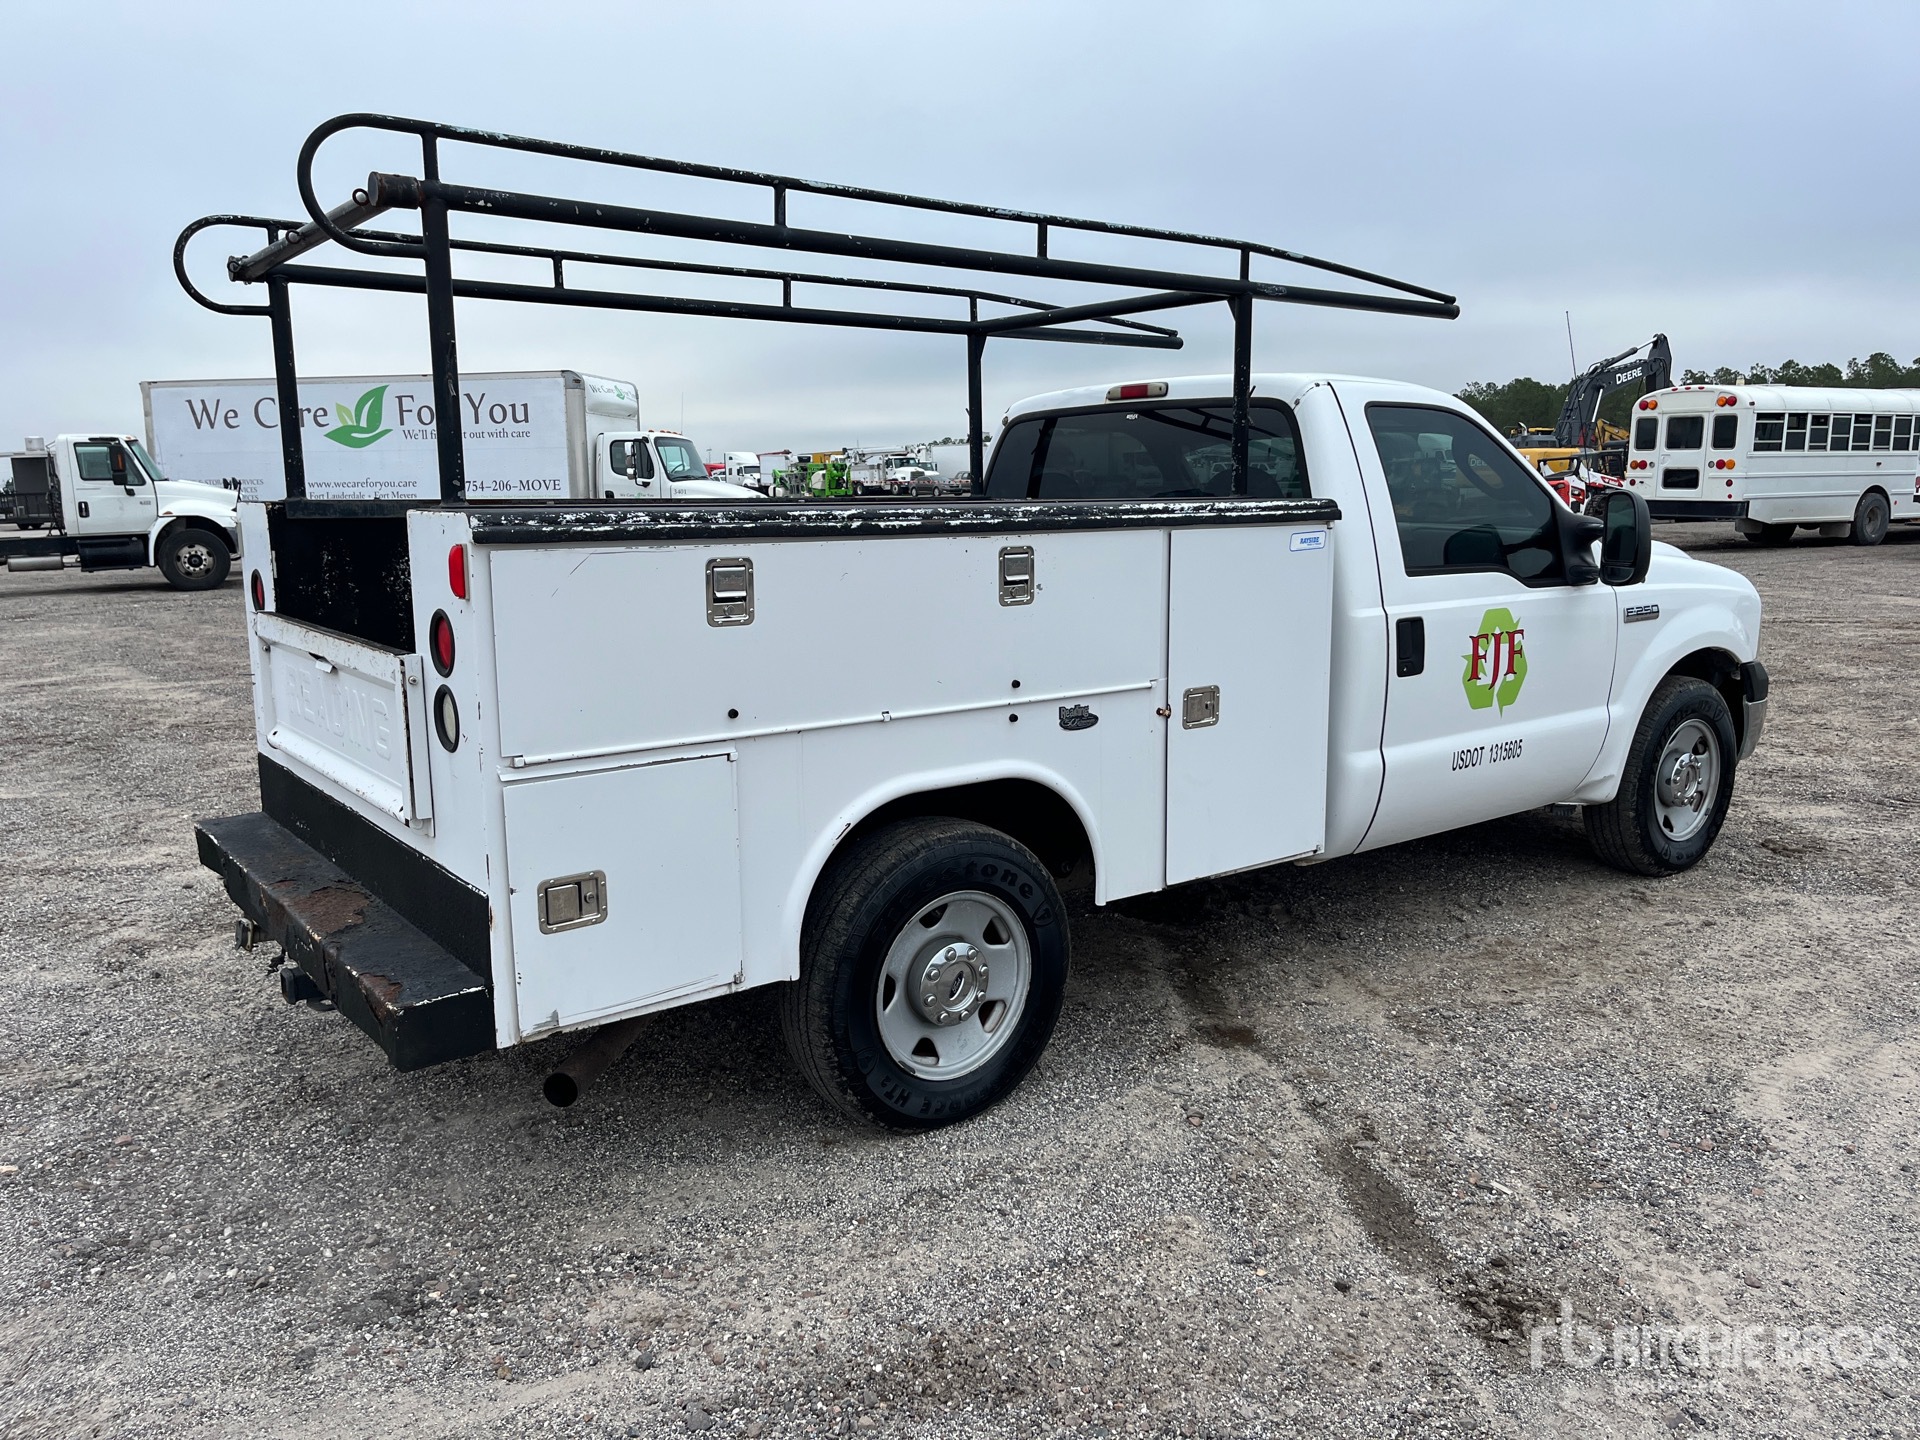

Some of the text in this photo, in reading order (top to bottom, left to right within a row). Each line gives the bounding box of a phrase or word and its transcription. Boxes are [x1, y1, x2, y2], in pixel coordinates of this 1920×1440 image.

[1616, 367, 1642, 384] DEERE
[185, 392, 529, 430] We Cre Fo You
[403, 429, 428, 440] We'll
[469, 430, 485, 439] out
[487, 428, 508, 439] with
[511, 429, 531, 439] care
[308, 477, 418, 491] www.wecareforyou.care
[465, 479, 561, 492] 754-206-MOVE
[310, 491, 324, 500] Fort
[1626, 604, 1660, 617] F-250
[1467, 629, 1525, 690] FJF
[1452, 738, 1523, 772] USDOT 1315605
